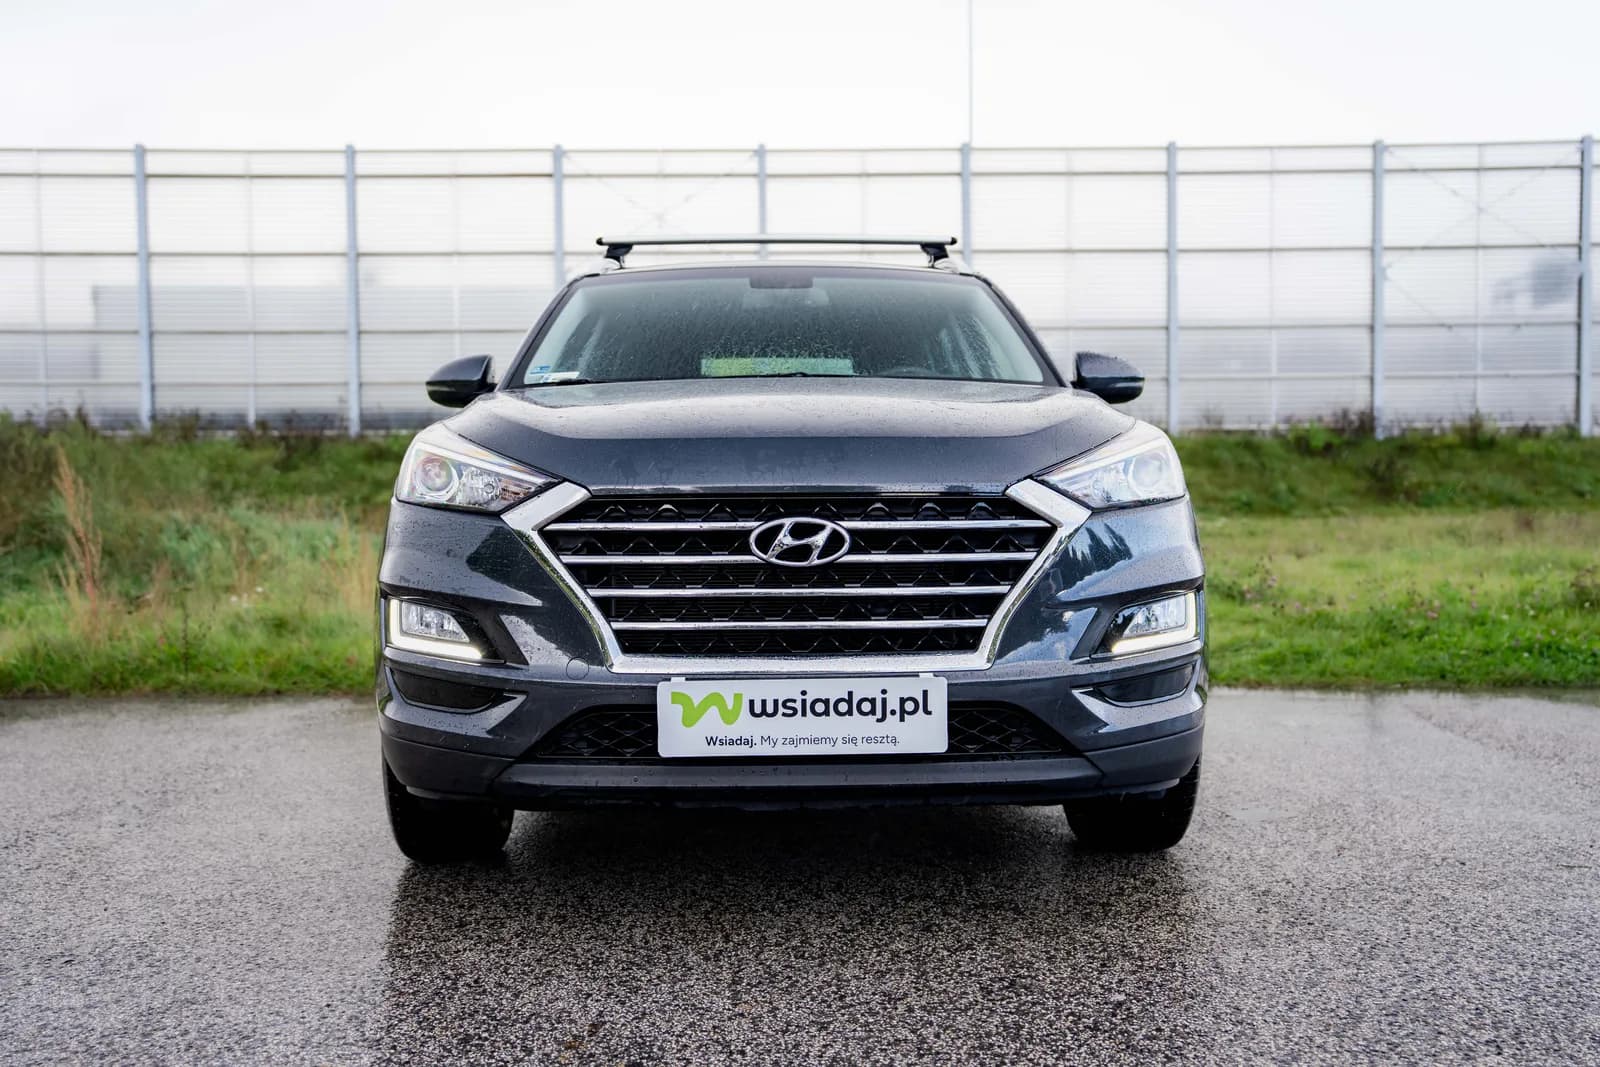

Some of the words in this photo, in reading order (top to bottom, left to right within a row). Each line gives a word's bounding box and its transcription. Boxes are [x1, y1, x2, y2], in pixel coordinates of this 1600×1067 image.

[749, 689, 933, 723] wsiadaj.pl
[704, 735, 757, 749] Wsiadaj.
[760, 735, 779, 747] My
[782, 734, 839, 748] zajmiemy
[841, 734, 858, 747] się
[861, 733, 900, 746] resztą.
